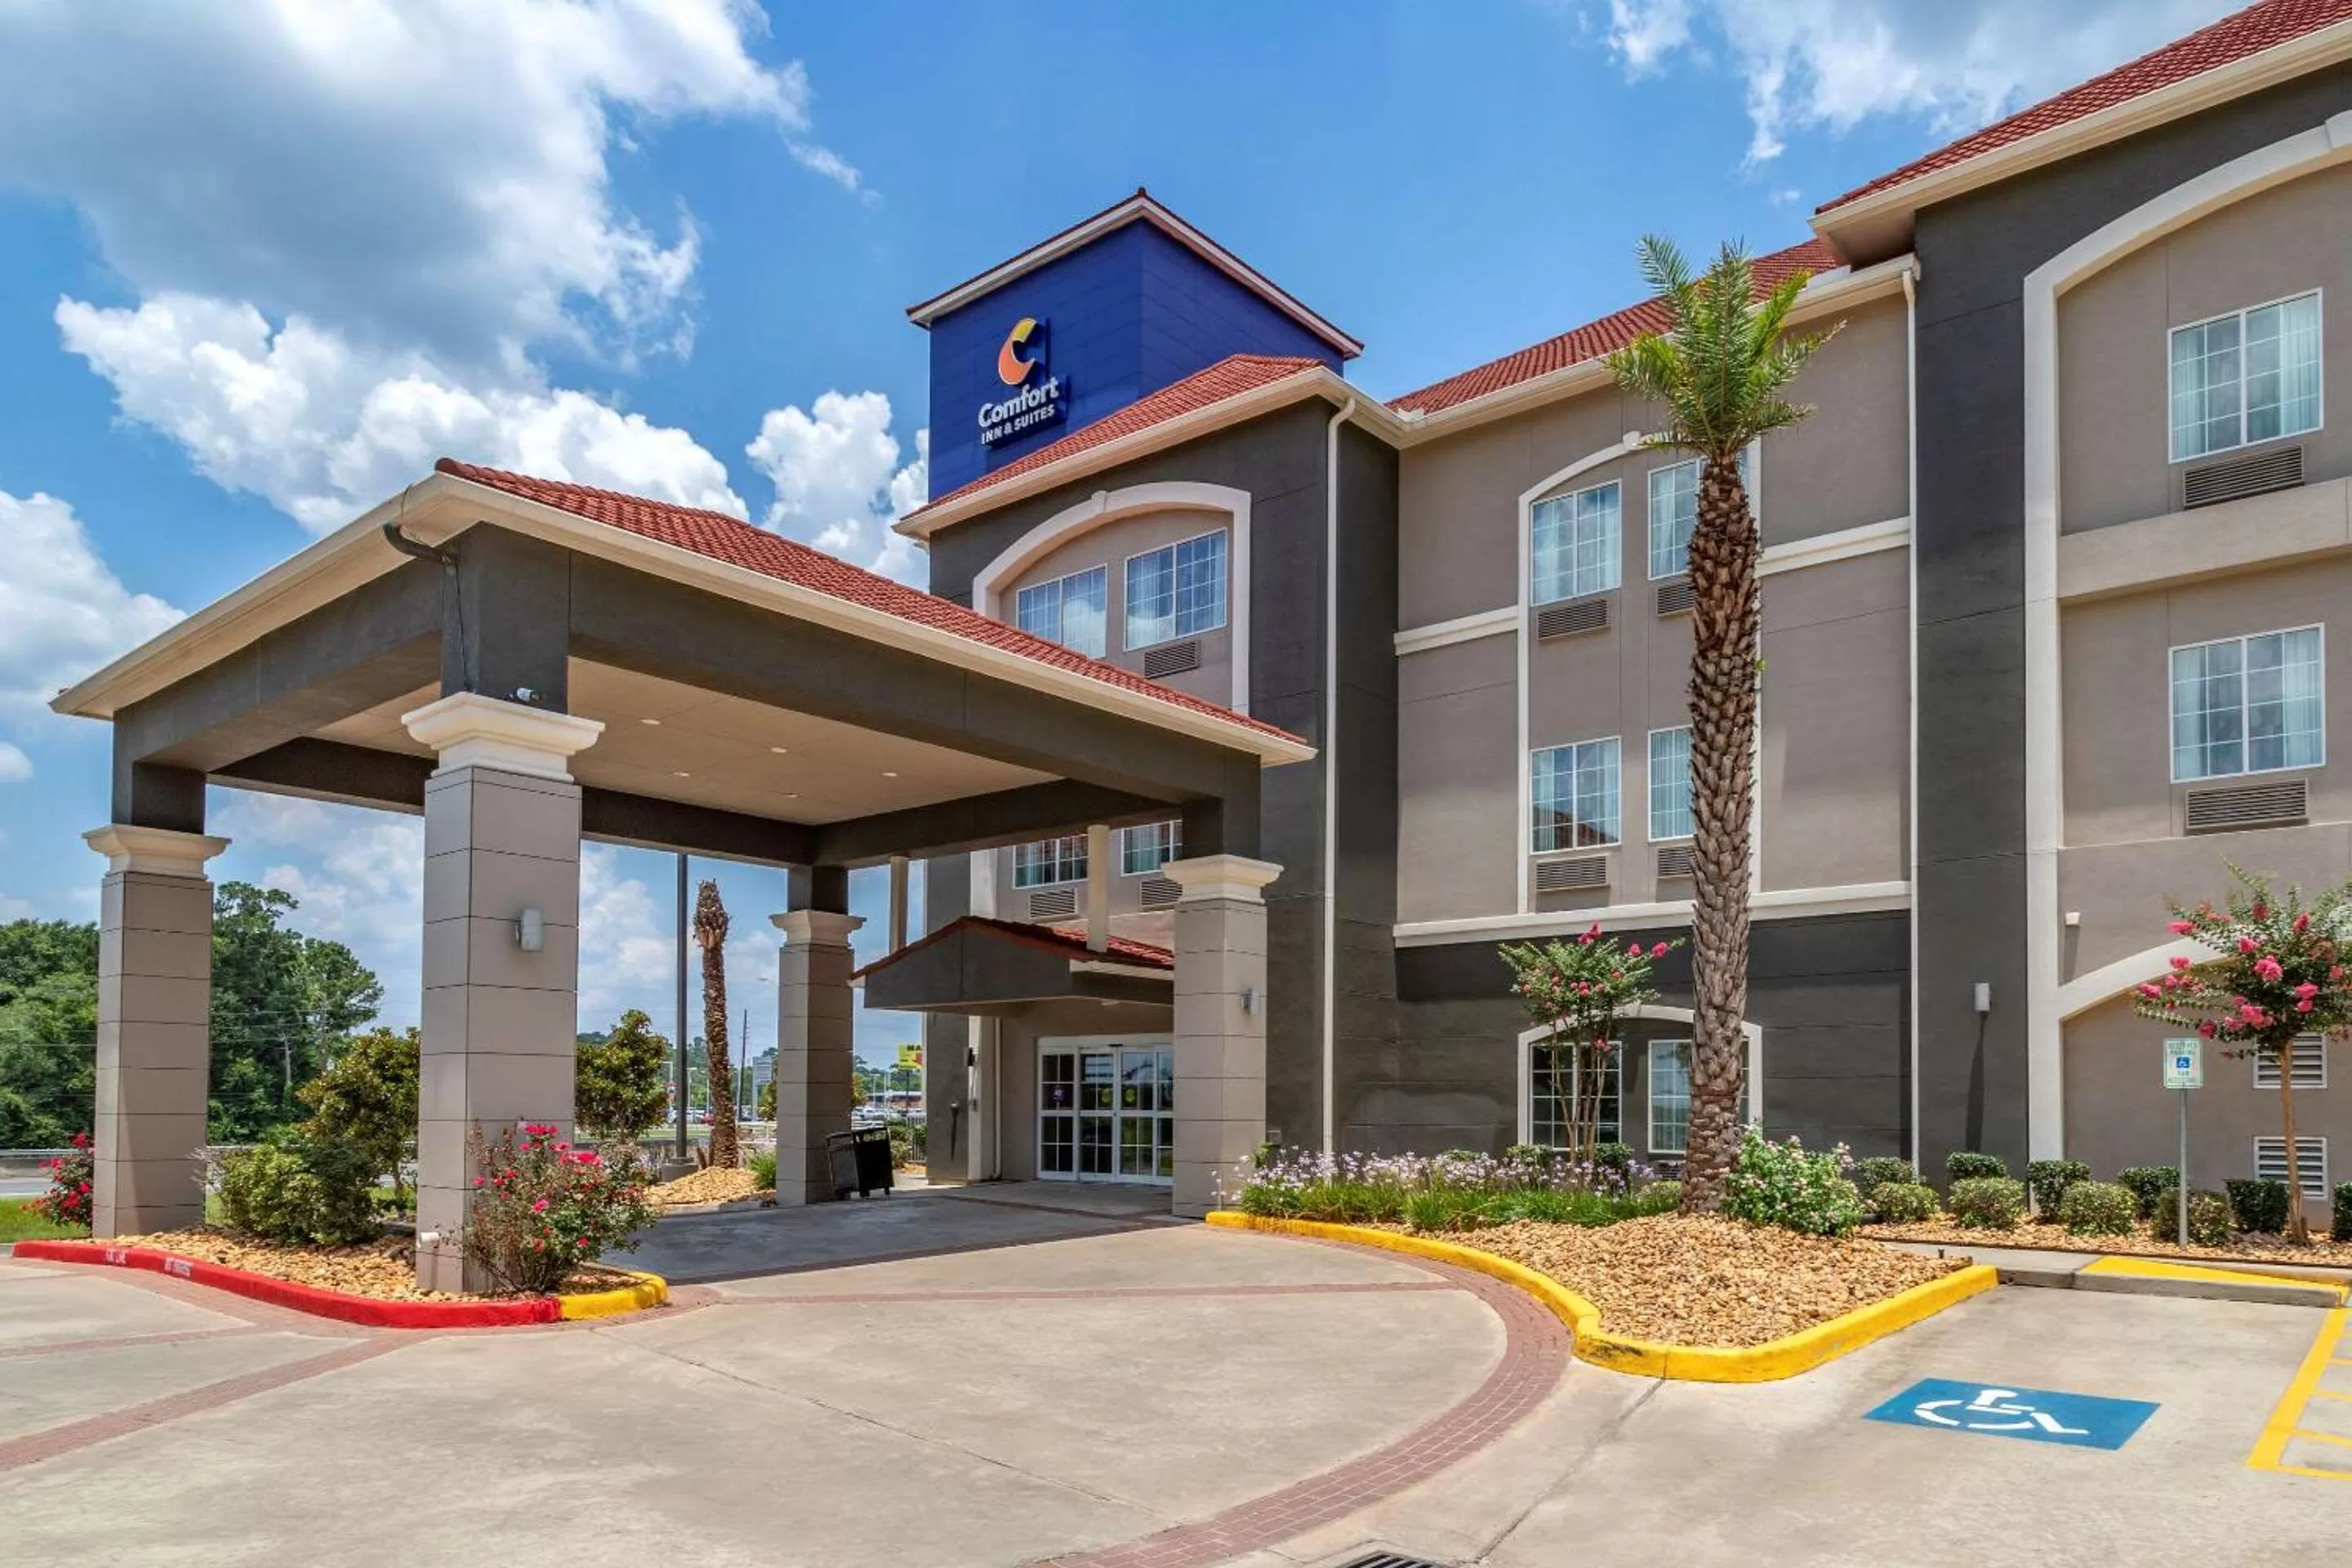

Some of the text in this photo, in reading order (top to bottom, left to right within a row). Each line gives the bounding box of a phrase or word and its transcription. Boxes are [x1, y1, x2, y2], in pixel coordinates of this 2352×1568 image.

[978, 377, 1058, 427] Comfort
[981, 404, 1054, 444] INN & SUITES
